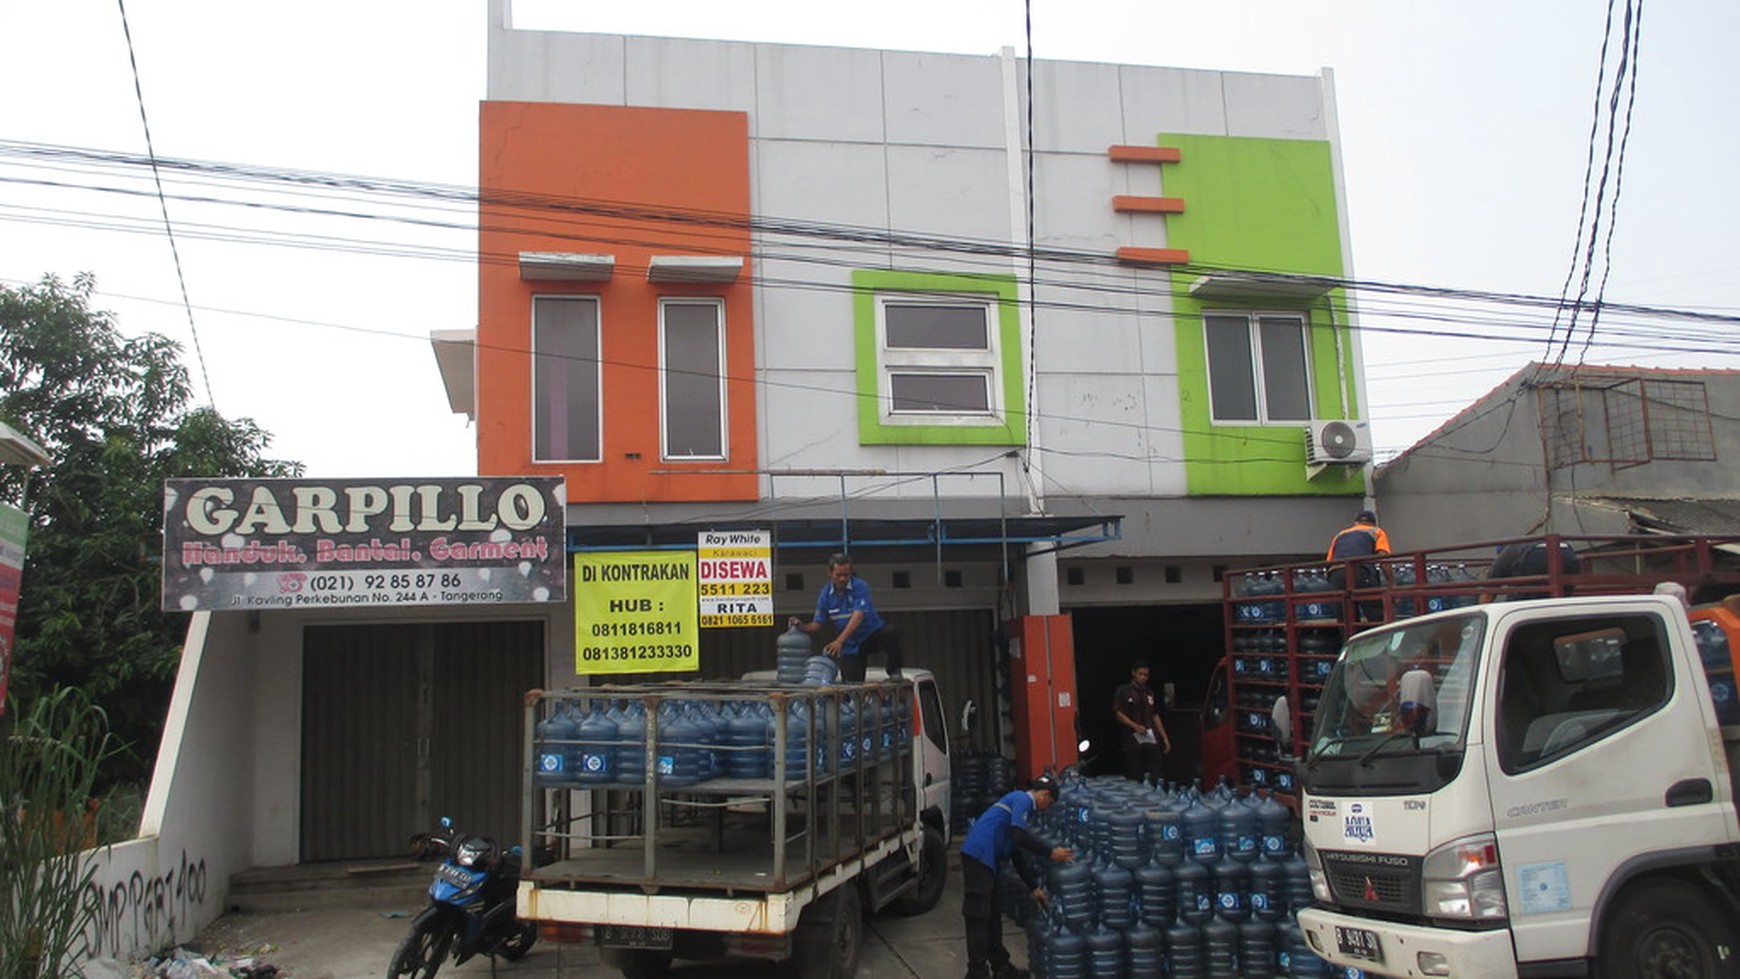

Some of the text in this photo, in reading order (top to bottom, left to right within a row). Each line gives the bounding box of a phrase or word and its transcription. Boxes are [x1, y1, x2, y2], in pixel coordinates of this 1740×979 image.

[186, 484, 546, 535] GARPILLO
[705, 532, 761, 546] Ray White
[430, 536, 548, 560] Garment
[713, 548, 757, 557] Karawaci
[582, 562, 690, 582] DI KONTRAKAN
[700, 560, 768, 579] DISEWA
[310, 573, 461, 591] (021) 92 85 87 86
[701, 582, 770, 596] 5511 223
[247, 594, 293, 607] Kavling
[296, 592, 370, 605] Perkebunan
[395, 591, 417, 602] 244
[419, 590, 429, 601] A
[441, 590, 504, 602] Tangerang
[610, 599, 652, 613] HUB
[717, 602, 757, 614] RITA
[701, 615, 724, 626] 0821
[592, 621, 682, 637] 0811816811
[583, 644, 693, 661] 081381233330
[1378, 856, 1409, 867] FUSO
